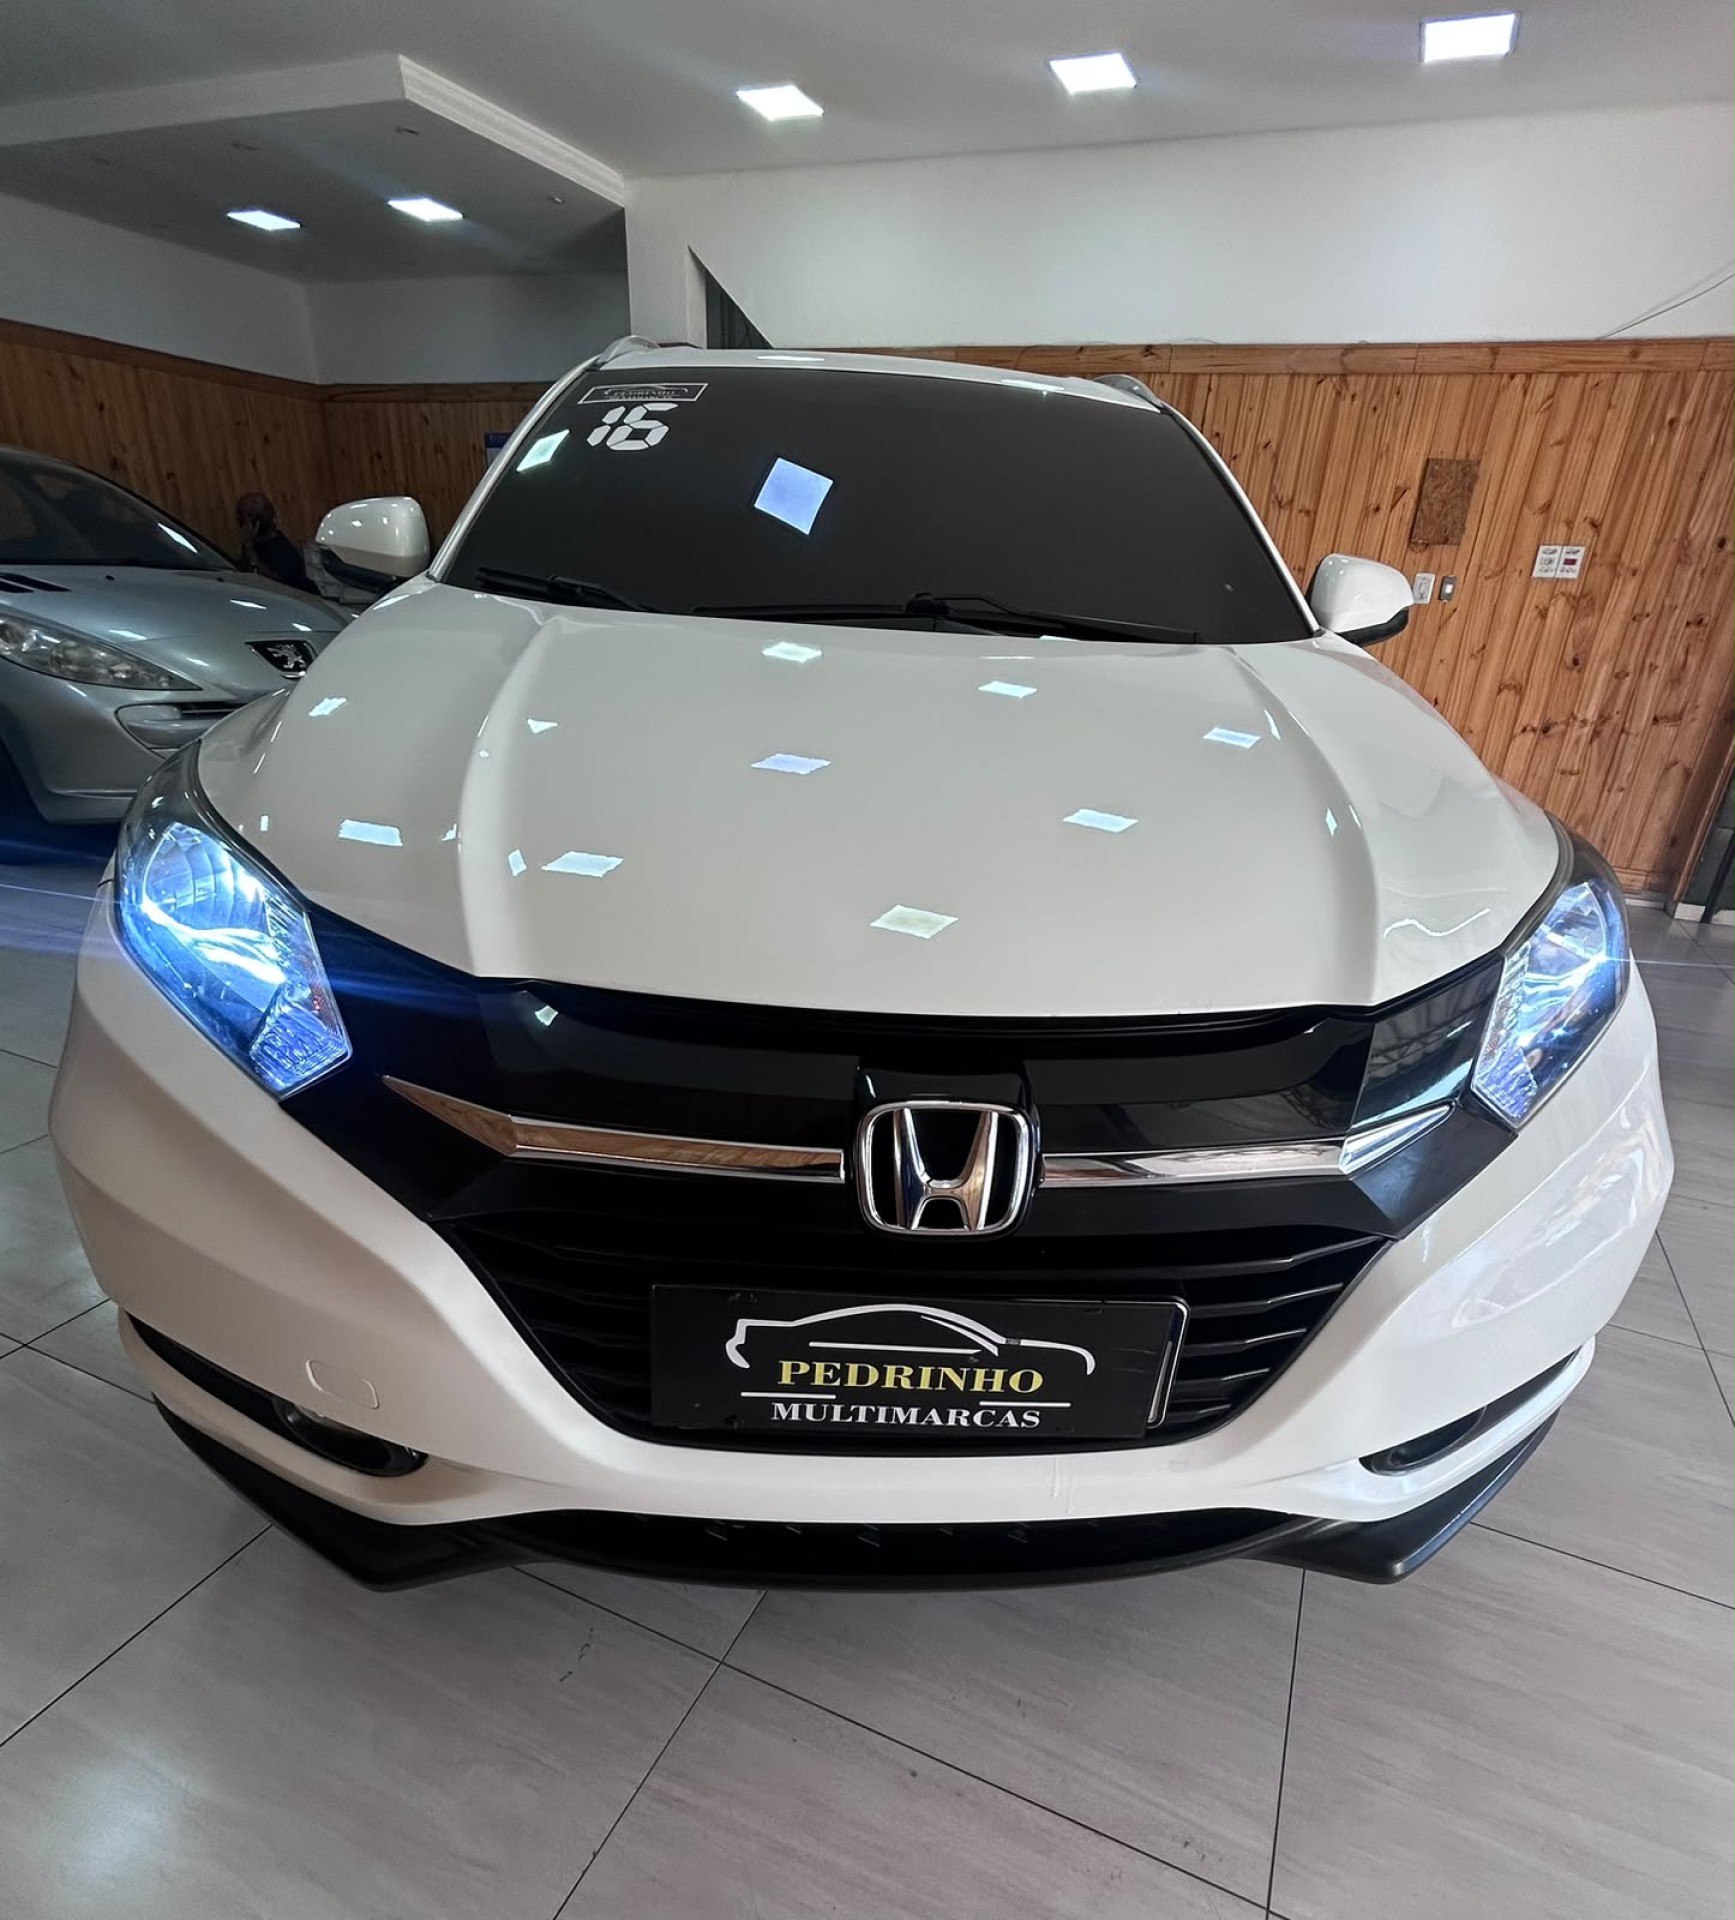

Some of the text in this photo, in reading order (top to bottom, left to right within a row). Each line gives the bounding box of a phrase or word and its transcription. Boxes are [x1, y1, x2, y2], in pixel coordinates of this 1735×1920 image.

[587, 402, 679, 451] 16
[777, 1360, 1043, 1393] PEDRINHO
[770, 1402, 1041, 1429] MULTIMARCAS
